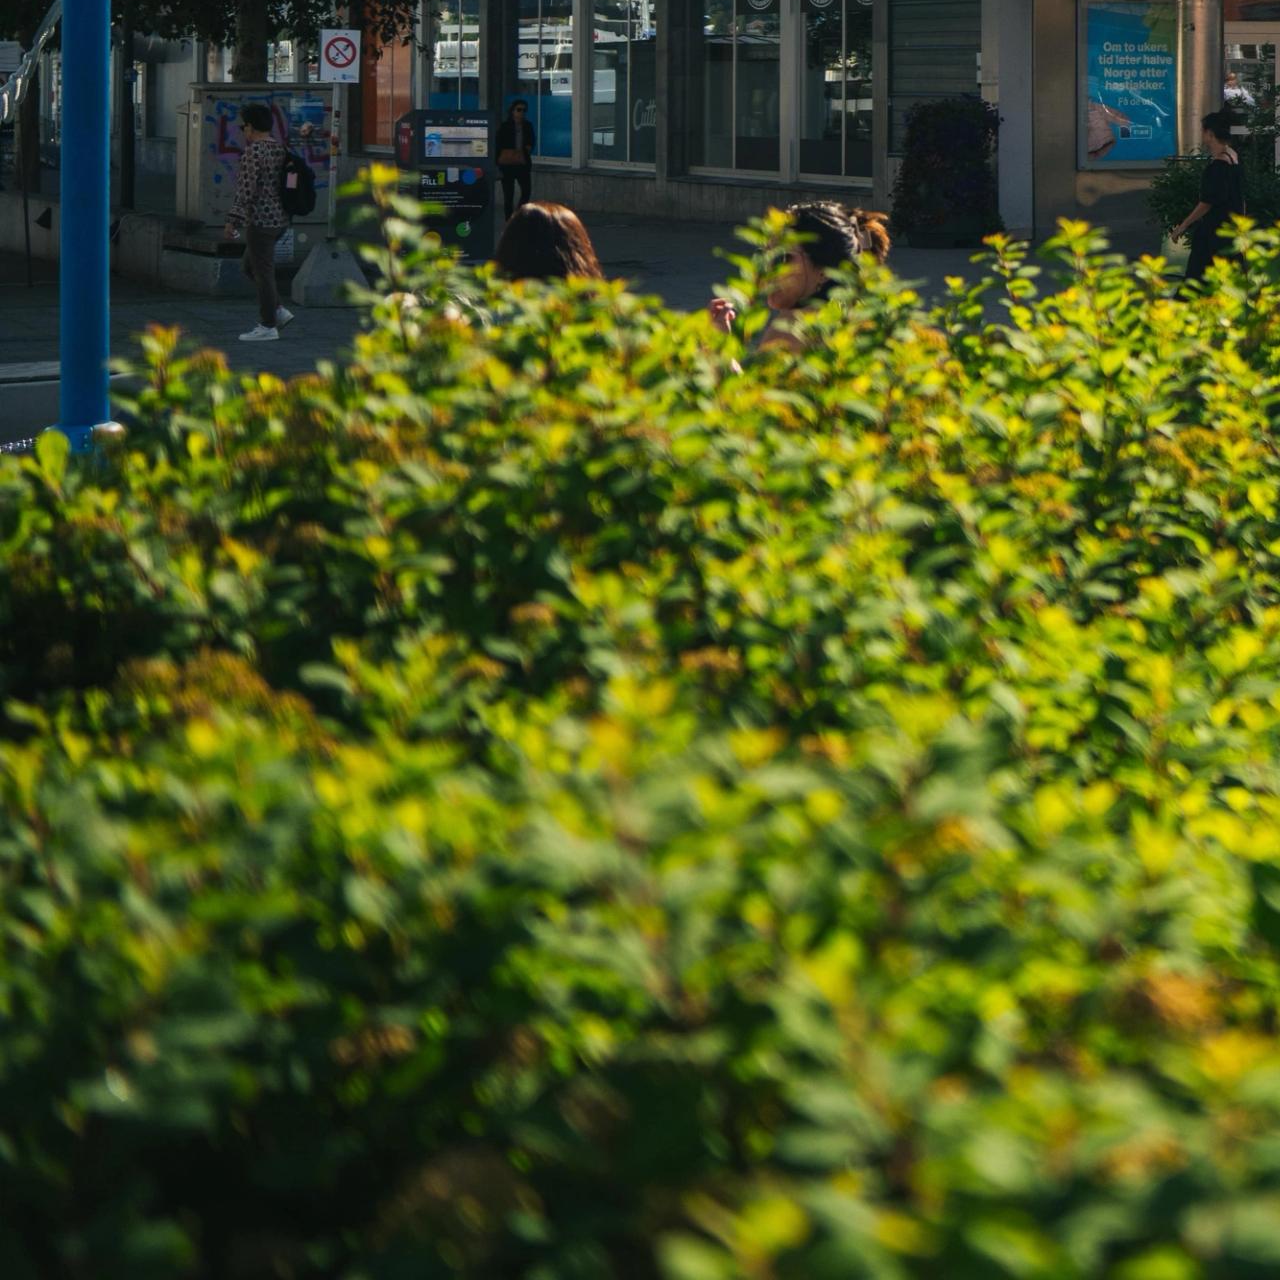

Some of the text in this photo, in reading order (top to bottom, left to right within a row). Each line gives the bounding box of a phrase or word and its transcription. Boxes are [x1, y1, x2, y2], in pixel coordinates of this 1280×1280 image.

[1103, 41, 1168, 53] Om to ukers
[1098, 54, 1174, 65] tid leter halve
[1103, 68, 1169, 80] Norge etter
